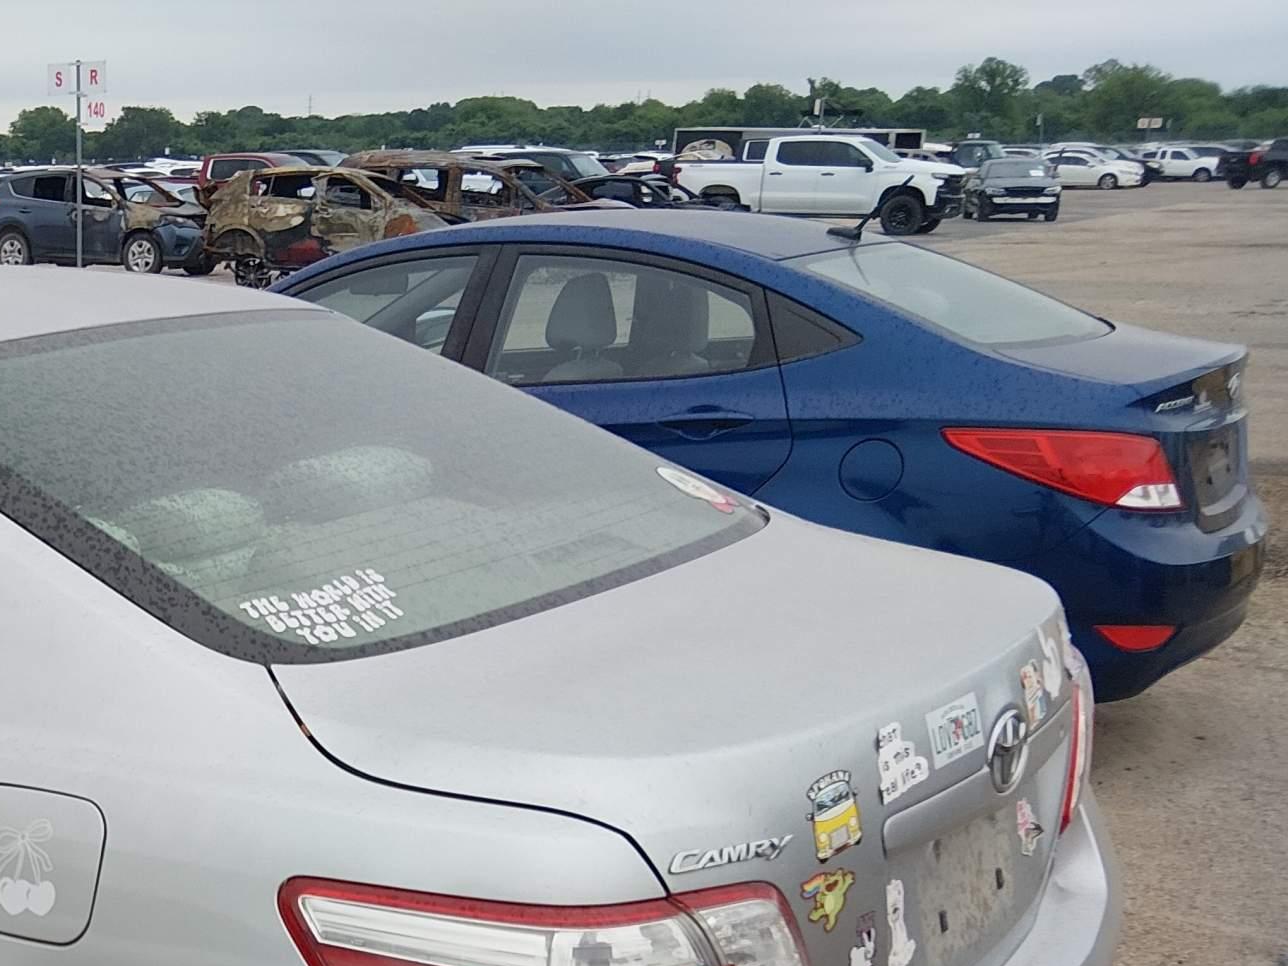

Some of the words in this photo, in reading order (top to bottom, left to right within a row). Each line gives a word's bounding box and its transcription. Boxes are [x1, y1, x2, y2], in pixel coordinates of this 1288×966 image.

[55, 71, 63, 87] S
[90, 69, 98, 85] R
[87, 101, 105, 118] 140
[239, 595, 290, 619] THE
[291, 575, 360, 610] WORLD
[265, 603, 351, 633] BETTER
[295, 621, 357, 645] YOU
[668, 833, 794, 875] CAMRY
